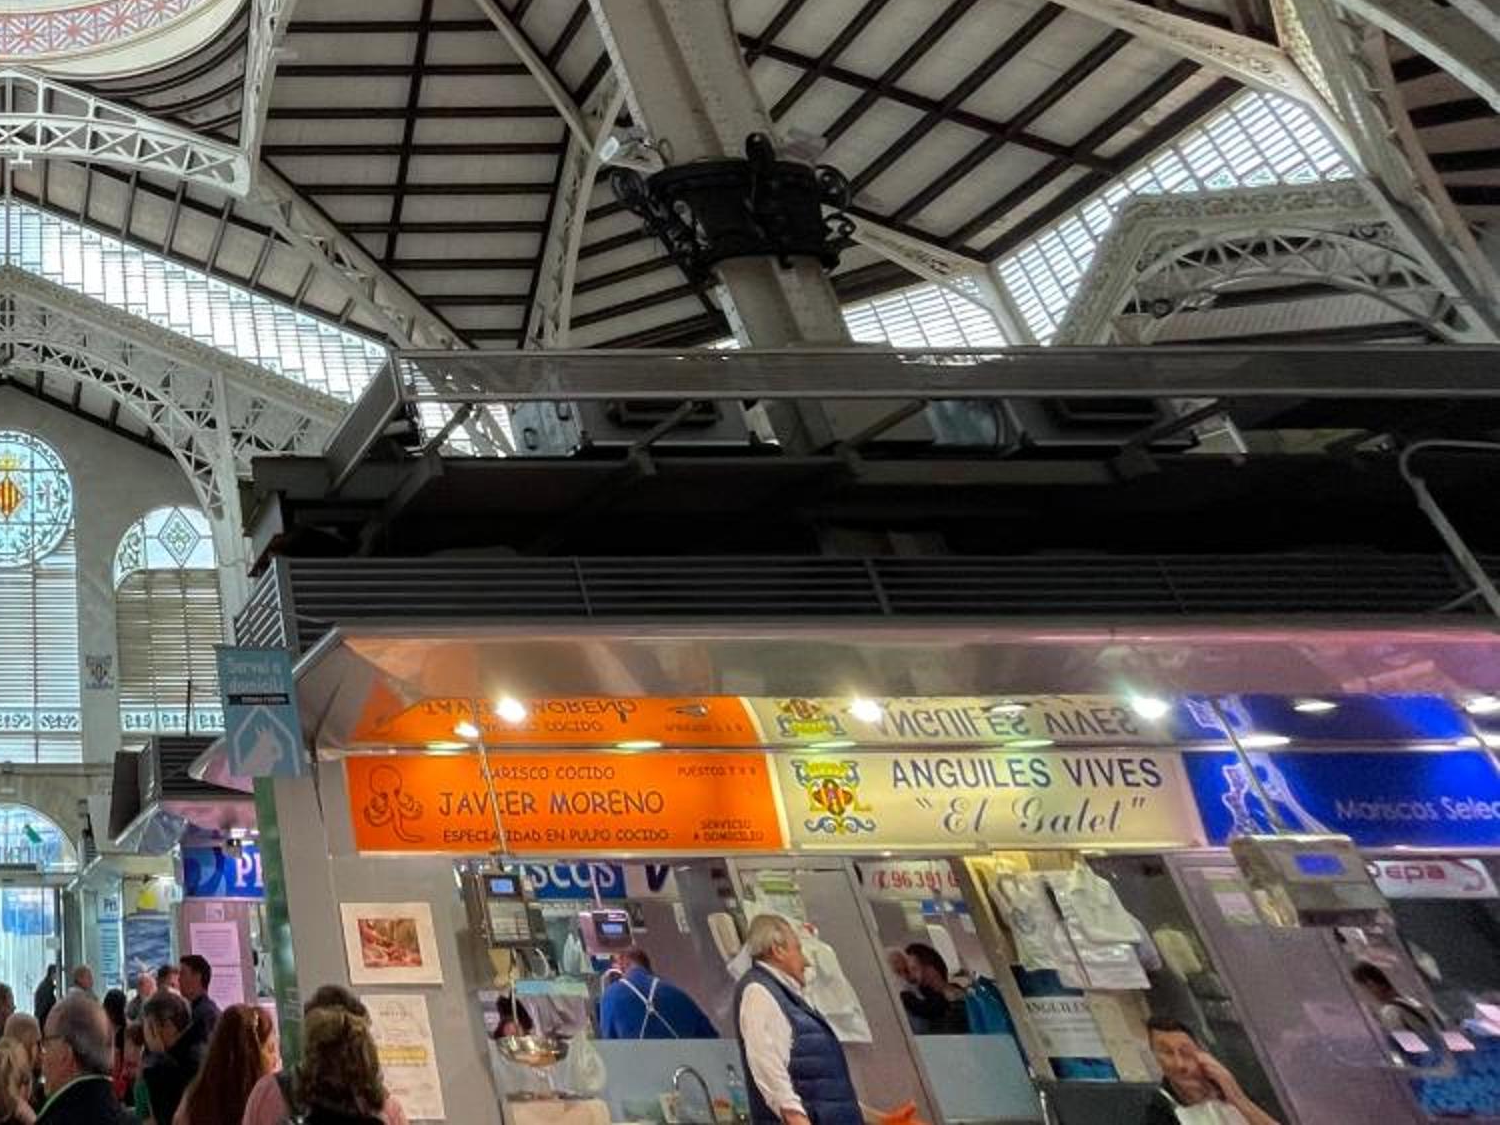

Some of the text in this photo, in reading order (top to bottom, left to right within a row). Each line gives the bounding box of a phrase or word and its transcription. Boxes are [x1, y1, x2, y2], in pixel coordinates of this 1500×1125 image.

[555, 765, 615, 781] COCIDO
[892, 757, 1163, 788] ANGUILES VIVES
[438, 789, 665, 816] JAVIER MORENO
[443, 828, 670, 843] ESPECIAIDAD EN PULPO COCIDO
